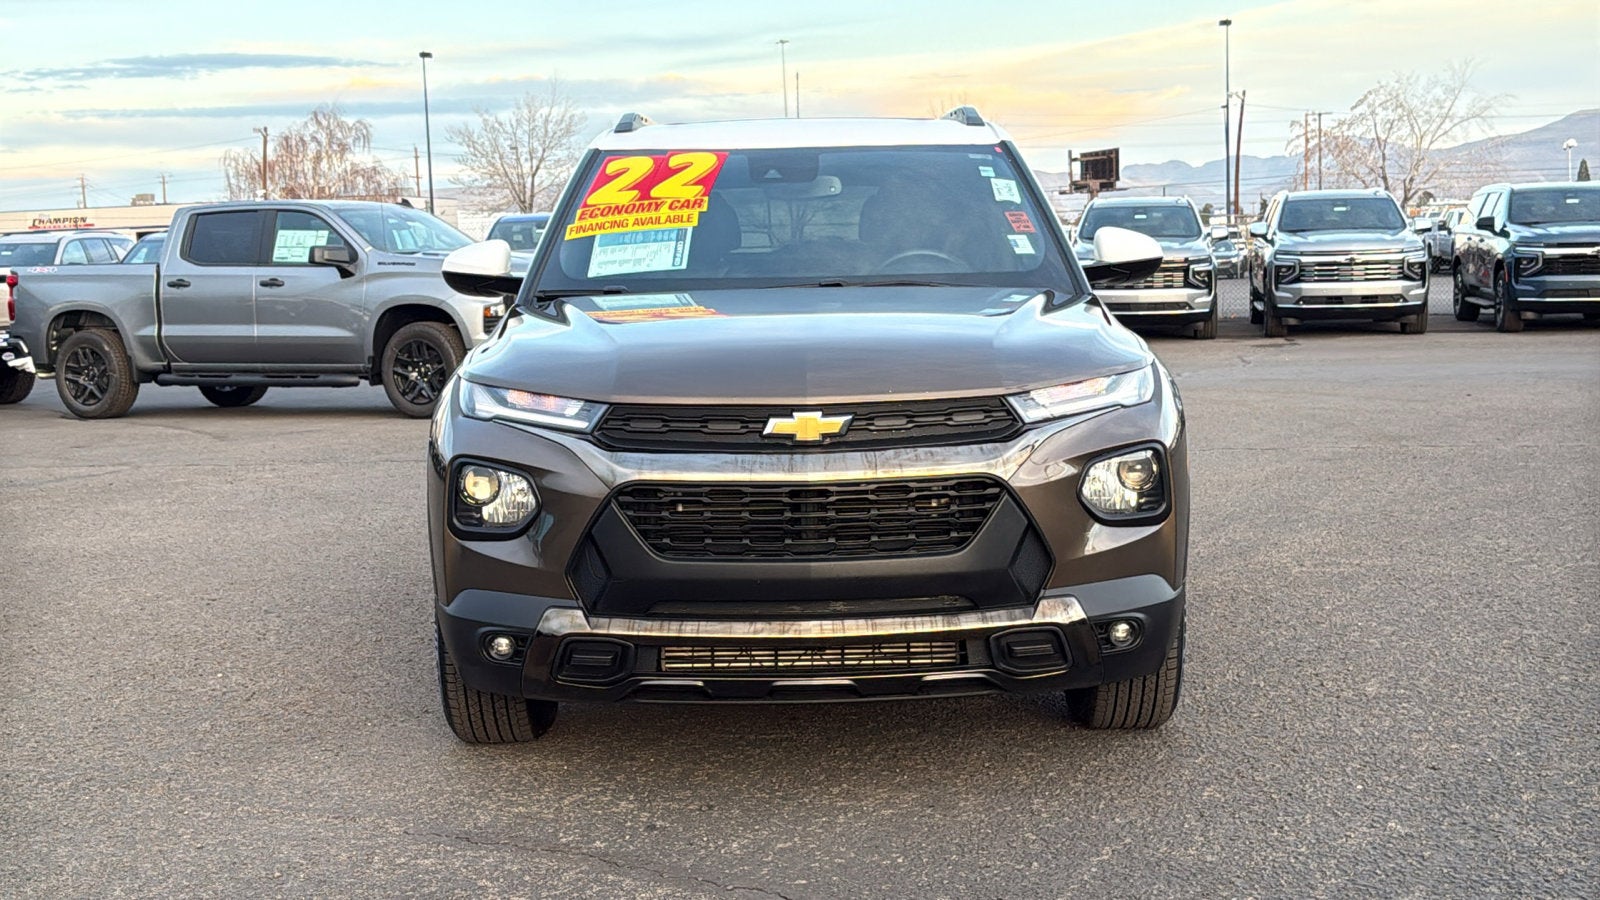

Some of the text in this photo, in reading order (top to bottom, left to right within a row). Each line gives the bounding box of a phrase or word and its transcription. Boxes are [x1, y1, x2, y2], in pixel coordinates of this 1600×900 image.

[587, 152, 718, 205] 22
[32, 216, 87, 226] CHAMPION
[578, 199, 705, 221] ECONOMY CAR
[569, 213, 694, 236] FINANCING AVAILABLE
